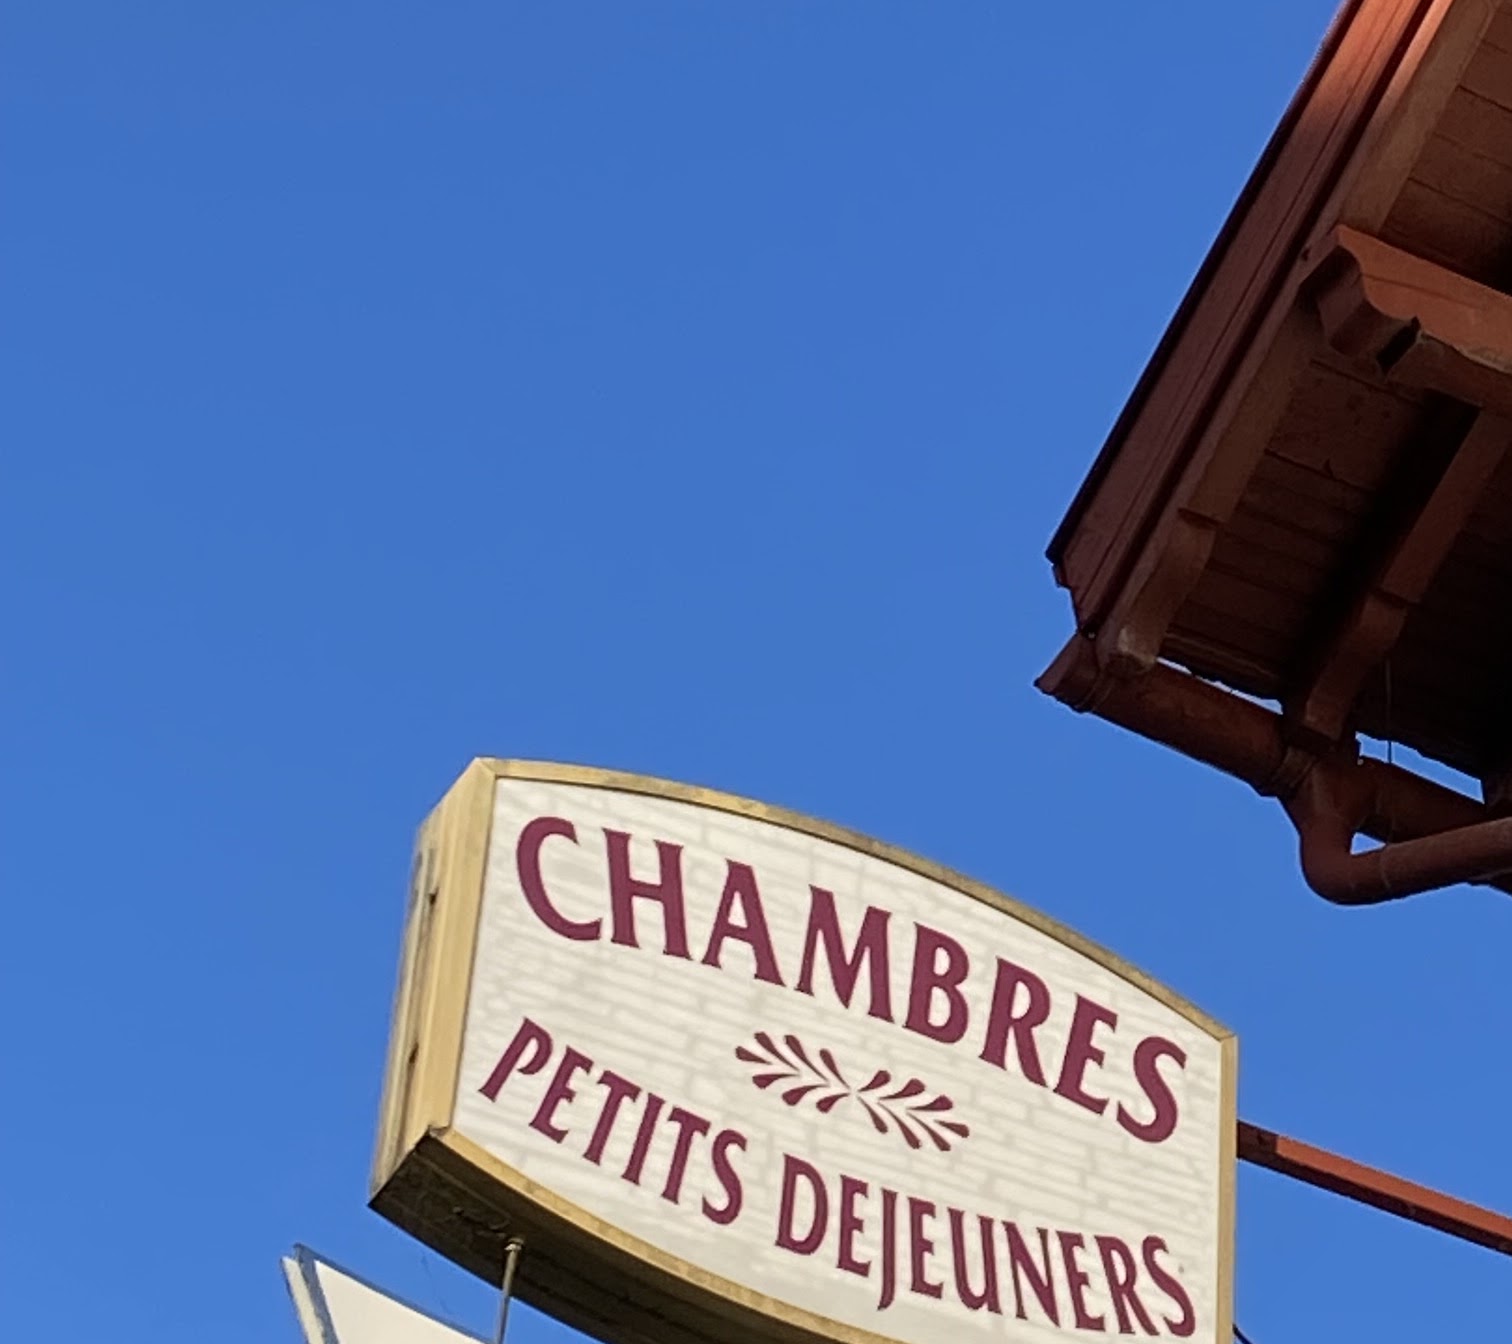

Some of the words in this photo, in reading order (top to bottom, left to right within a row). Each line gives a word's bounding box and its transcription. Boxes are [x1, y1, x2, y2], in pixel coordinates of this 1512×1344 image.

[514, 816, 1187, 1144] CHAMBRES
[478, 1018, 748, 1225] PETITS
[776, 1153, 1197, 1339] DEJEUNERS
